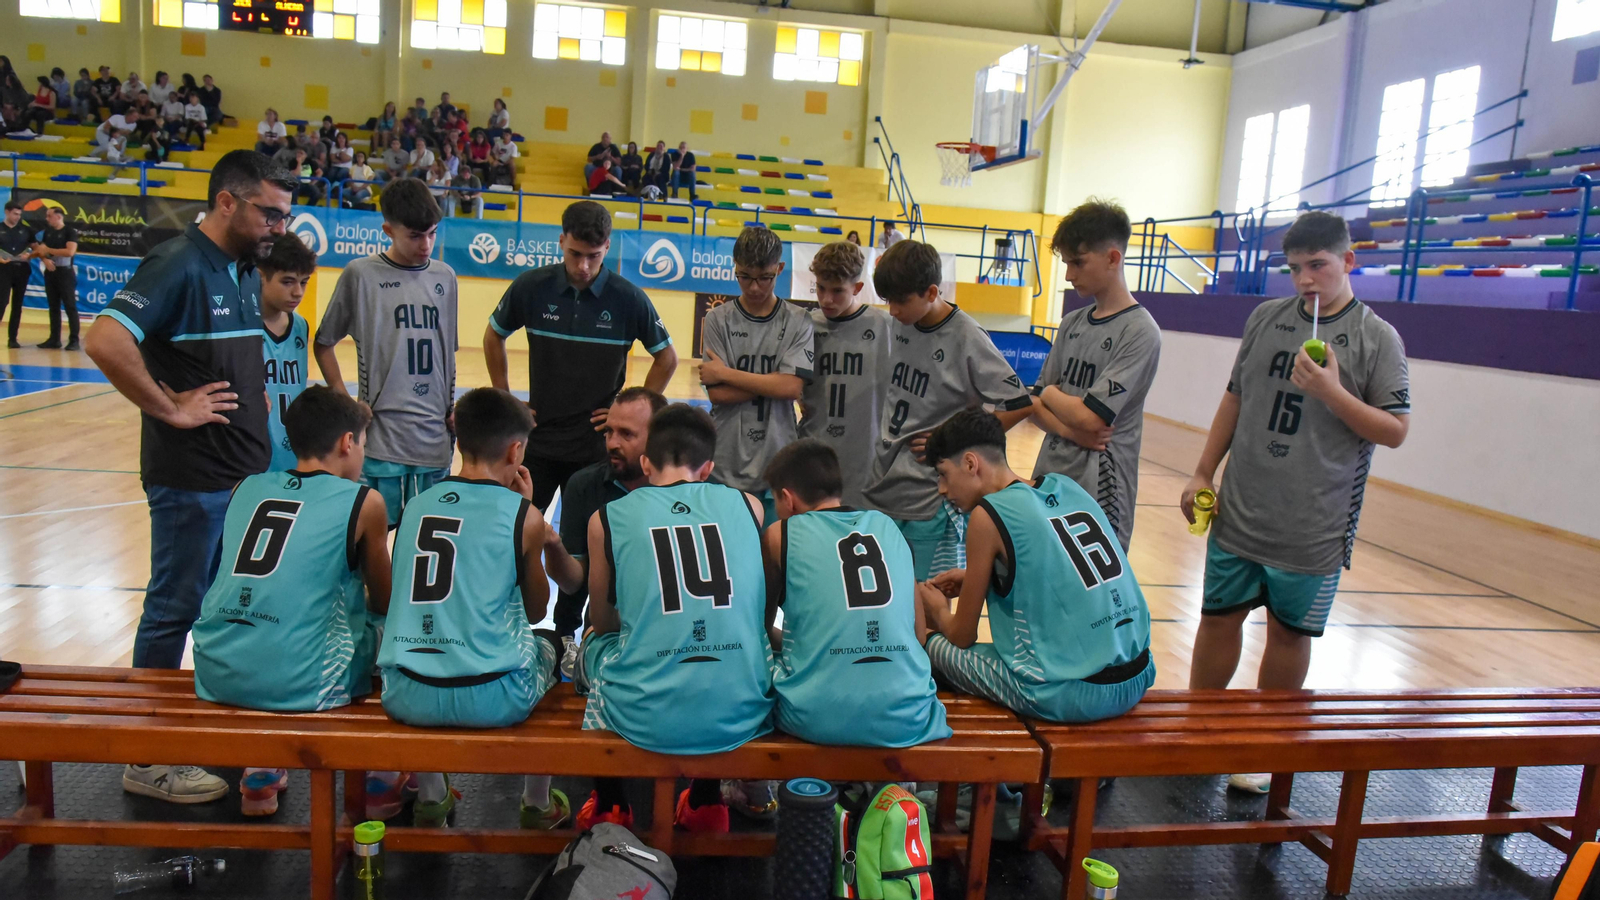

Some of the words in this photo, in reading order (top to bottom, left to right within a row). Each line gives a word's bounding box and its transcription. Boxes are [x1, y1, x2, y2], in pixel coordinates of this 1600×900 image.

[111, 238, 131, 246] 2021
[335, 222, 391, 242] balonc
[86, 265, 135, 285] Diput
[691, 264, 739, 282] andal
[379, 280, 401, 289] vive
[86, 288, 107, 304] de
[212, 307, 230, 316] vive
[394, 304, 440, 330] ALM
[542, 312, 560, 321] vive
[730, 330, 749, 338] vive
[1275, 323, 1296, 333] vive
[895, 334, 910, 345] vive
[408, 337, 433, 376] 10
[819, 352, 864, 376] ALM
[891, 361, 930, 399] ALM
[828, 383, 847, 418] 11
[888, 399, 910, 436] 9
[1267, 390, 1304, 436] 15
[231, 498, 304, 578] 6
[410, 514, 464, 604] 5
[1047, 510, 1124, 591] 13
[649, 523, 734, 615] 14
[836, 531, 893, 611] 8
[1090, 610, 1122, 630] DIPUTACÓN
[656, 645, 700, 658] DIPUTACIÓN
[712, 641, 743, 652] ALMERÍA
[829, 645, 873, 656] DIPUTACIÓN
[911, 839, 921, 858] 4
